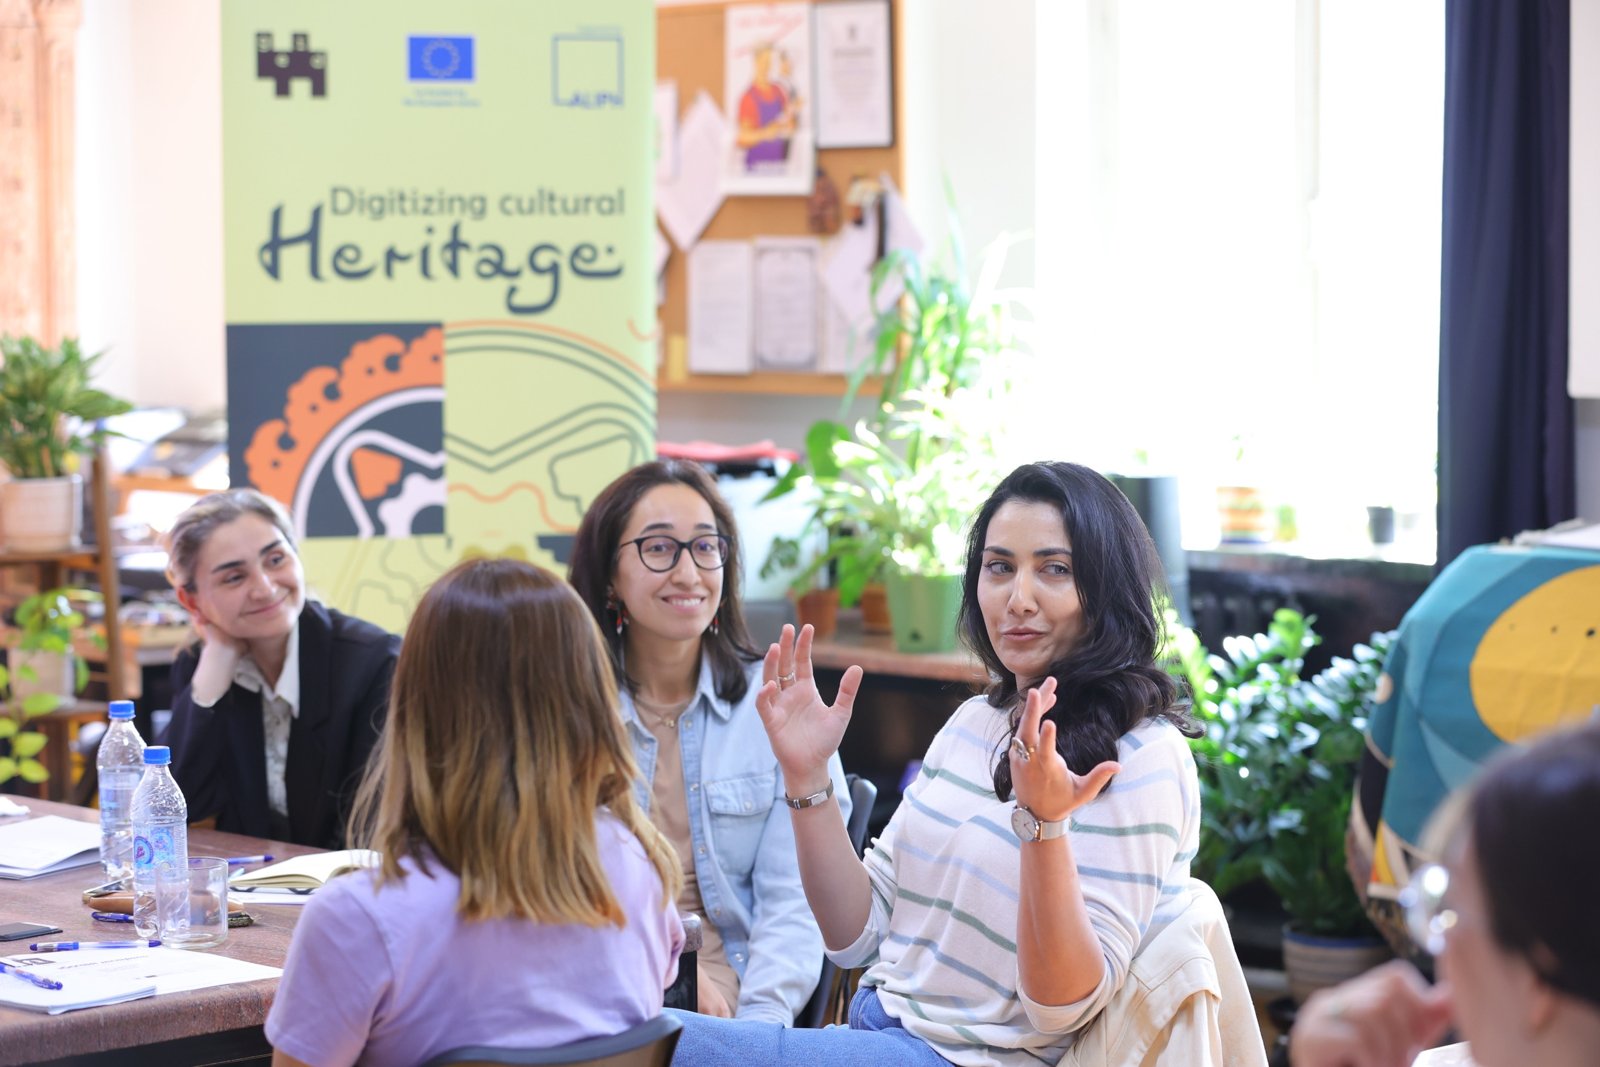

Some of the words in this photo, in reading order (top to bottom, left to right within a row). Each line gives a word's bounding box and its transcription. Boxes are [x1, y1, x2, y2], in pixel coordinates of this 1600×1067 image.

[330, 187, 487, 220] Digitizing
[499, 188, 624, 216] cultural
[258, 203, 624, 315] Heritage
